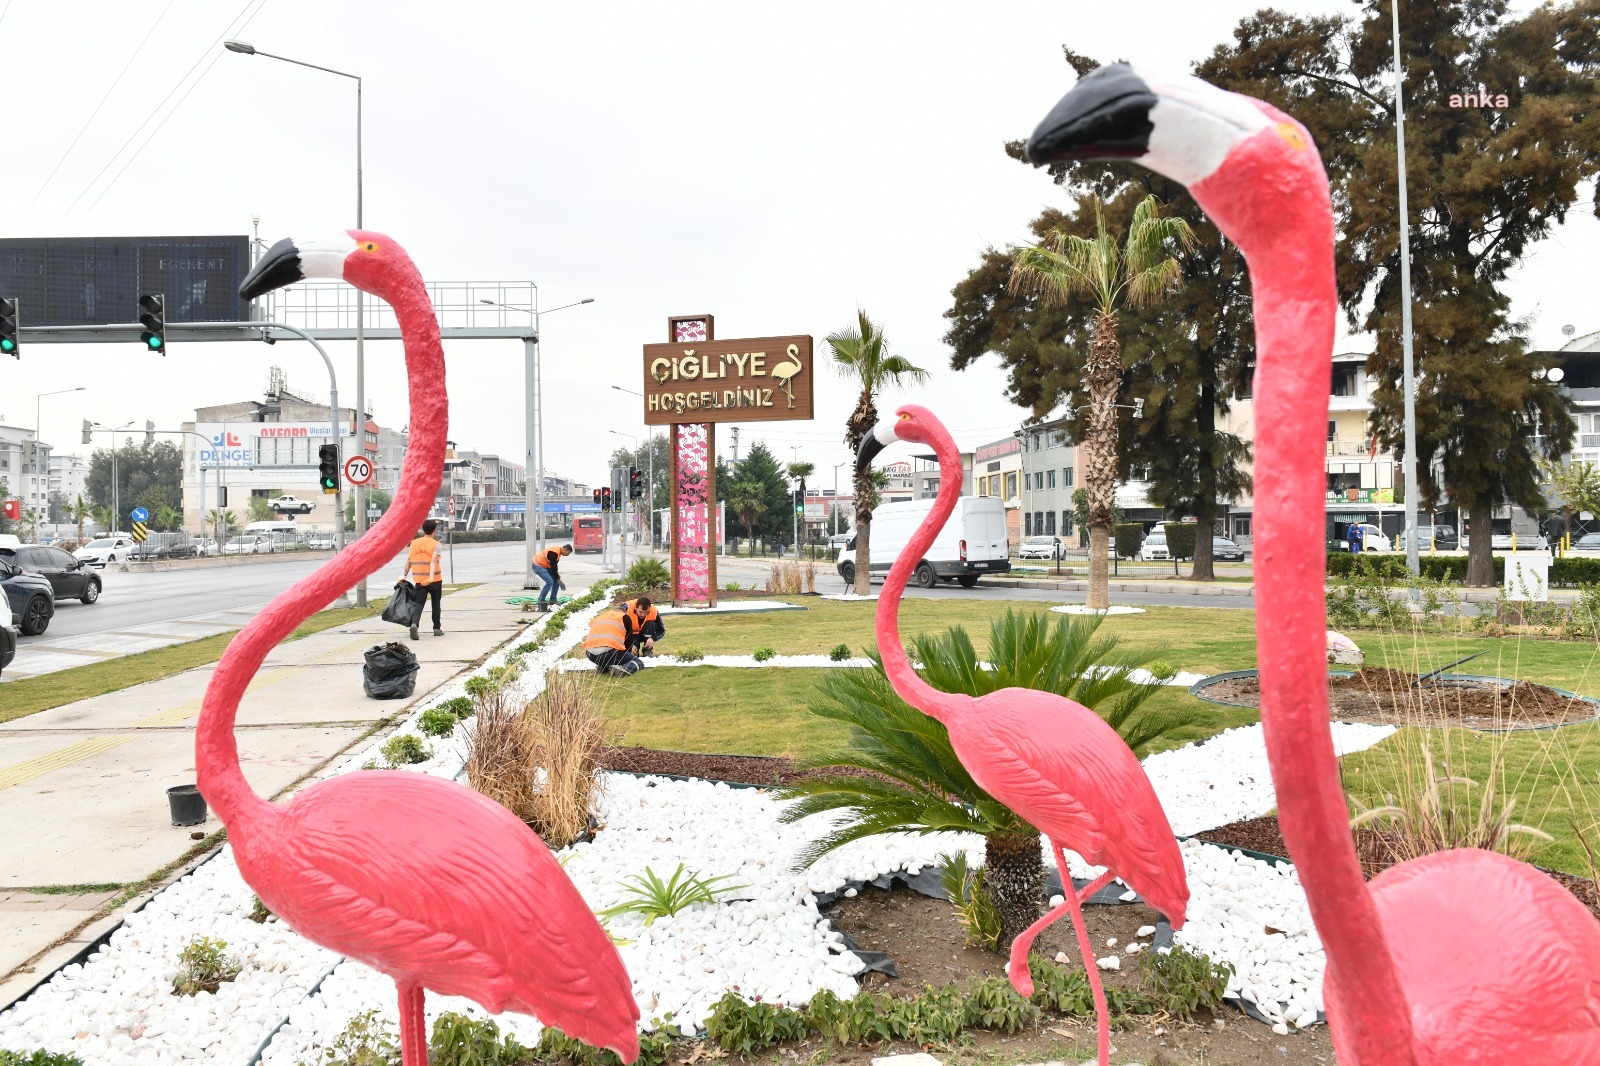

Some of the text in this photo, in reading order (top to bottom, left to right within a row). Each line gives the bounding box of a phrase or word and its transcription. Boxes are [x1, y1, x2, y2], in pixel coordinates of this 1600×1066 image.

[159, 258, 224, 270] EGEKENT
[648, 385, 774, 414] HOŞGELDİNİZ
[200, 450, 252, 461] DENGE
[351, 464, 369, 477] 70
